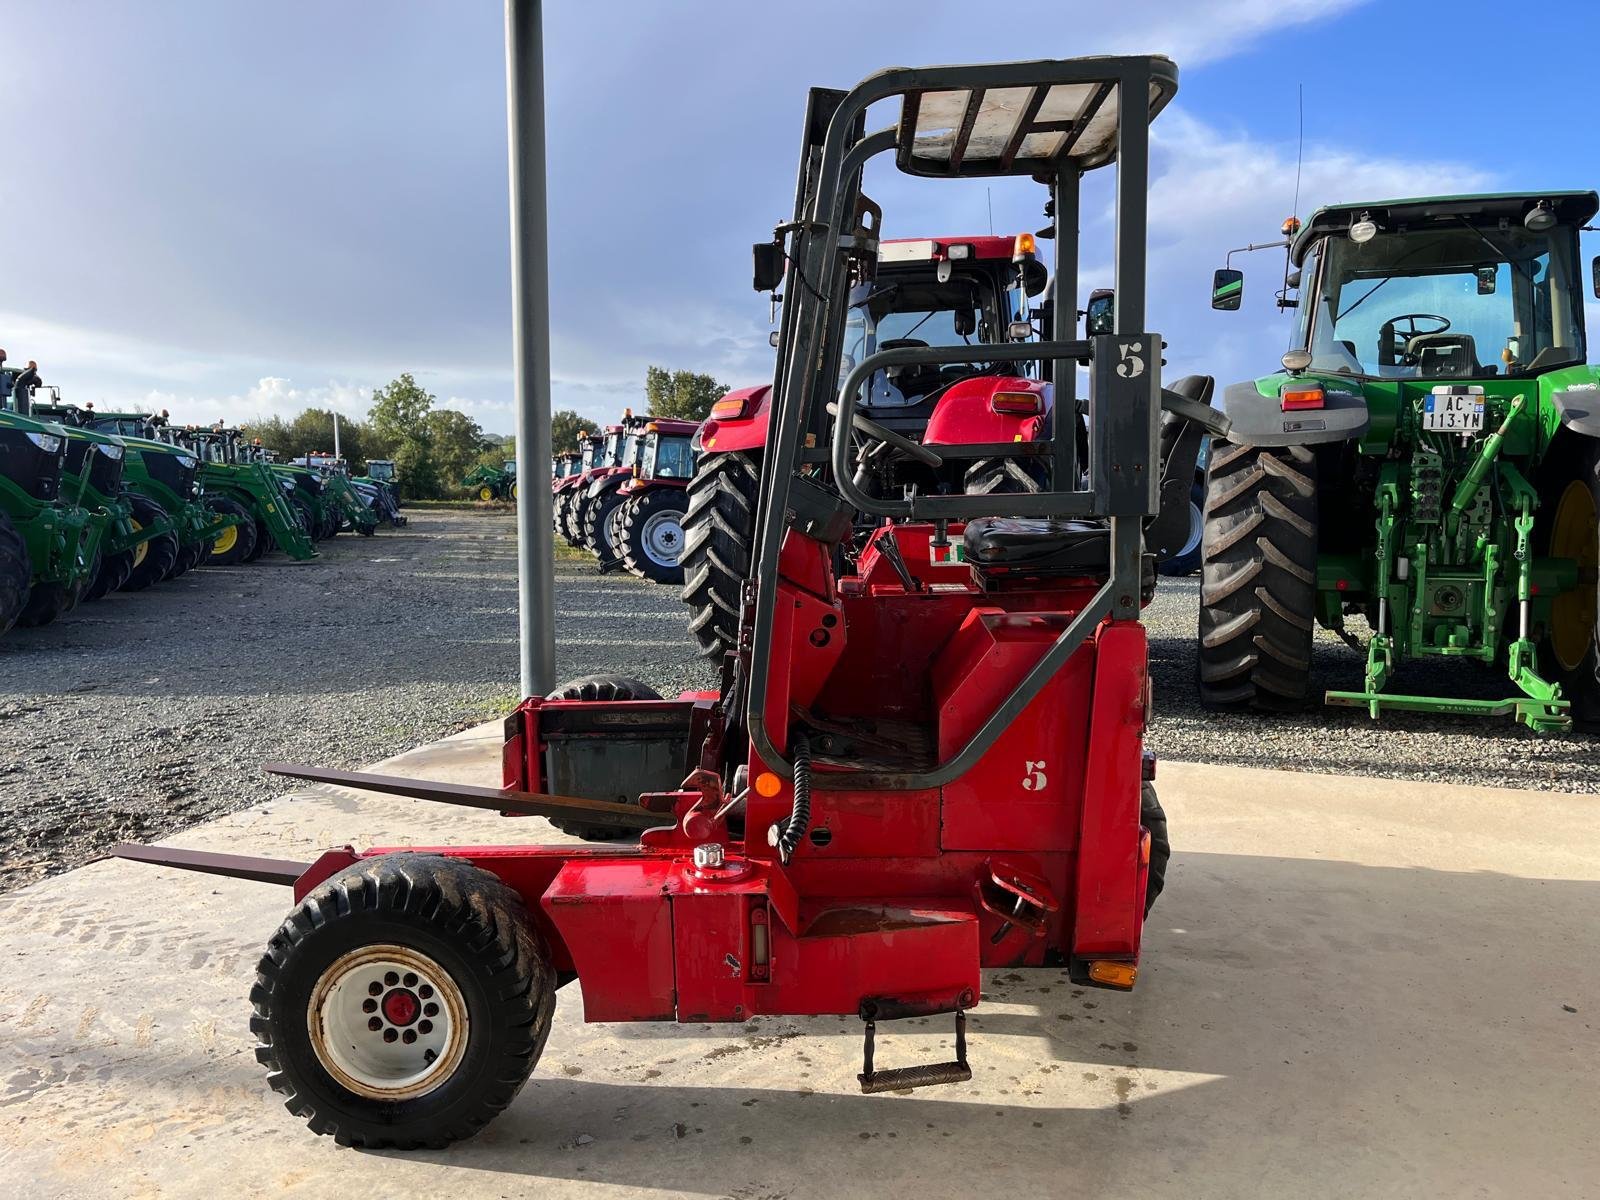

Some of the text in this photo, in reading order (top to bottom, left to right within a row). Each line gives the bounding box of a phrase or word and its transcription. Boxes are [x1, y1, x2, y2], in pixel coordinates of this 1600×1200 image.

[1116, 342, 1144, 378] 5
[1430, 413, 1480, 428] 113-YN
[1022, 760, 1047, 791] 5
